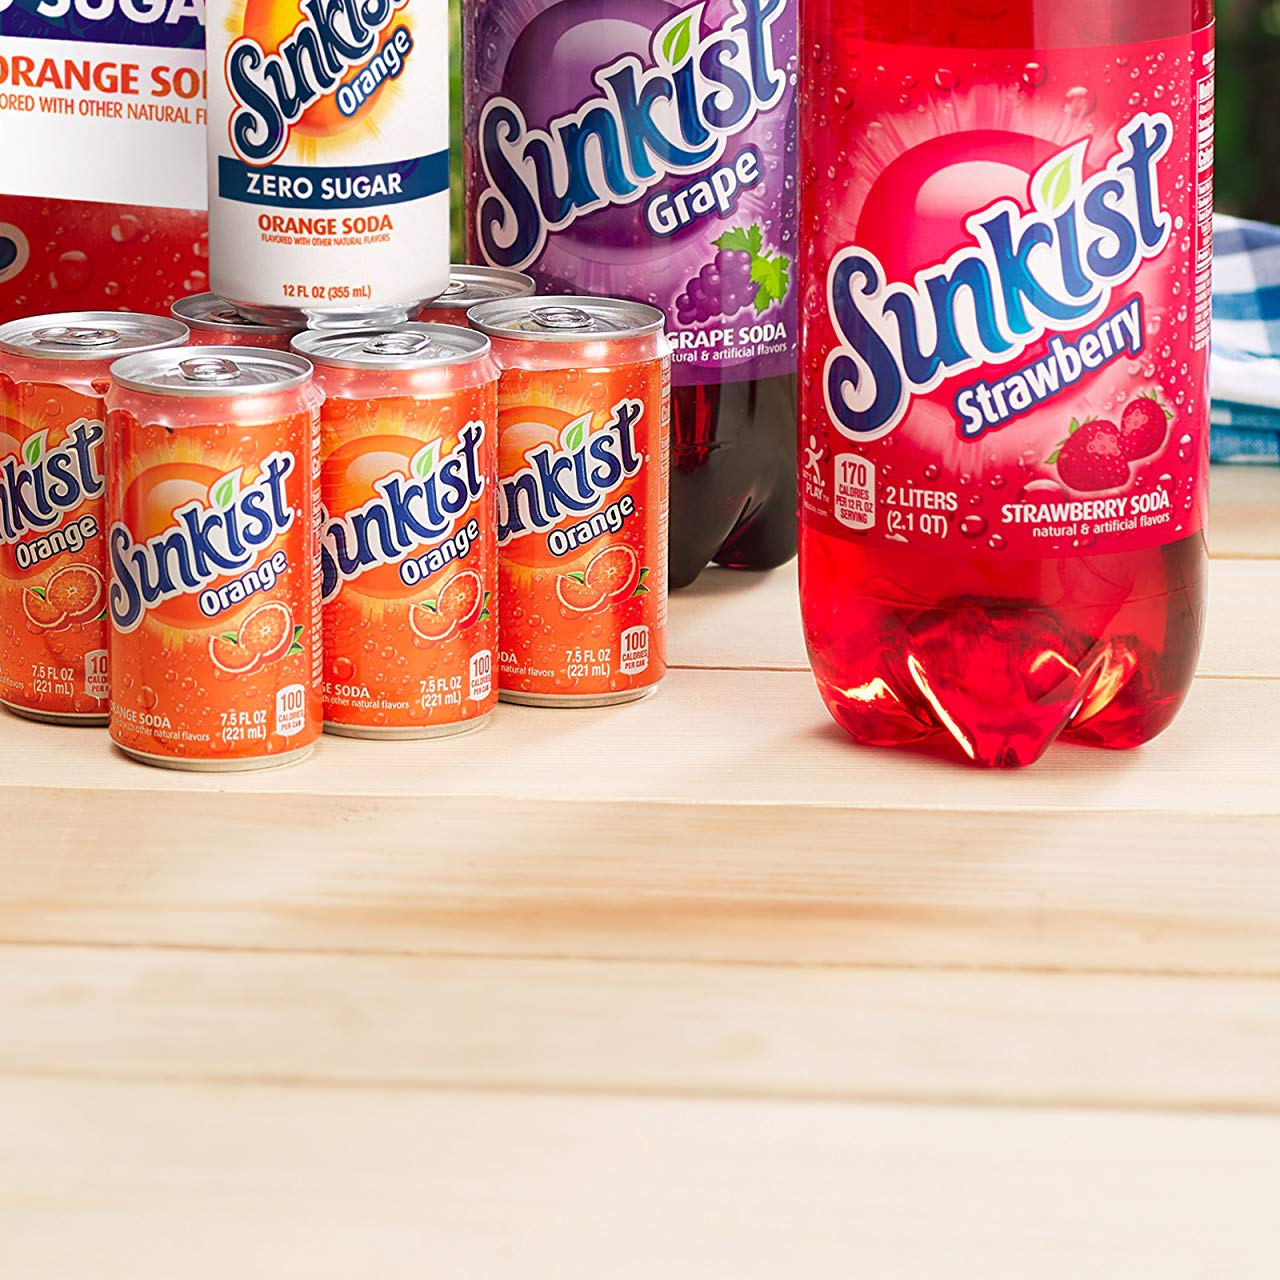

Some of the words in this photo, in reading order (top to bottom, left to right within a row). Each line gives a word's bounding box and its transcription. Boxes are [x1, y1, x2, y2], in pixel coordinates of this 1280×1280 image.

[338, 29, 410, 115] Orange
[151, 66, 207, 99] SO
[39, 96, 74, 115] WITH
[78, 99, 122, 119] OTHER
[127, 103, 192, 125] NATURAL
[246, 172, 313, 199] ZERO
[321, 172, 403, 200] SUGAR
[647, 151, 760, 234] Grape
[258, 214, 337, 235] ORANGE
[341, 214, 393, 235] SODA
[261, 234, 292, 245] FLAVORED
[294, 237, 311, 246] WITH
[312, 237, 332, 247] OTHER
[333, 235, 362, 246] NATURAL
[363, 233, 390, 244] FLAVORS
[828, 122, 1167, 431] Sunkist
[283, 284, 295, 297] 12
[298, 285, 308, 298] FL
[312, 286, 325, 298] OZ
[328, 285, 350, 299] (355
[352, 284, 371, 299] mL)
[667, 329, 734, 350] GRAPE
[738, 322, 787, 344] SODA
[672, 351, 698, 362] tural
[700, 350, 709, 361] &
[712, 346, 755, 360] artificial
[758, 342, 787, 355] flavors
[956, 303, 1142, 433] Strawberry
[498, 403, 640, 540] nkist
[841, 460, 867, 487] 170
[839, 484, 870, 500] CALORIES
[886, 487, 897, 505] 2
[900, 487, 958, 511] LITERS
[836, 495, 847, 507] PER
[848, 498, 855, 509] 12
[856, 500, 863, 511] FL
[864, 501, 873, 513] OZ
[1001, 497, 1127, 523] STRAWBERRY
[1130, 490, 1170, 515] SODA
[549, 495, 634, 556] Orange
[840, 508, 868, 524] SERVING
[887, 509, 914, 532] (2.1
[920, 514, 948, 539] QT)
[1033, 524, 1077, 538] natural
[1080, 524, 1089, 535] &
[1093, 517, 1137, 534] artificial
[1140, 511, 1170, 528] flavors
[16, 516, 98, 568] Orange
[111, 456, 291, 628] Sunkist
[401, 520, 479, 585] Orange
[200, 552, 288, 617] Orange
[624, 629, 647, 652] 100
[91, 656, 108, 674] 10
[472, 654, 490, 677] 100
[566, 650, 582, 663] 7.5
[584, 650, 595, 662] FL
[598, 649, 611, 662] OZ
[622, 650, 648, 662] CALORIES
[624, 660, 635, 670] PER
[32, 665, 46, 678] 7.5
[48, 666, 58, 680] FL
[61, 668, 74, 681] OZ
[501, 665, 526, 675] natural
[528, 666, 555, 677] flavors
[567, 664, 589, 678] (221
[591, 663, 611, 678] mL)
[33, 679, 52, 694] (221
[55, 683, 74, 698] mL)
[420, 680, 436, 693] 7.5
[437, 678, 448, 692] FL
[450, 676, 462, 690] OZ
[471, 675, 491, 688] CALORIES
[473, 686, 481, 696] PER
[280, 689, 303, 711] 100
[335, 684, 370, 699] SODA
[421, 693, 443, 709] (221
[444, 691, 462, 706] mL)
[328, 696, 349, 706] other
[352, 699, 379, 709] natural
[381, 700, 410, 710] flavors
[139, 713, 171, 729] SODA
[220, 713, 237, 726] 7.5
[239, 711, 251, 725] FL
[253, 710, 267, 723] OZ
[278, 711, 304, 722] CALORIES
[281, 721, 291, 731] PER
[136, 724, 152, 736] other
[154, 727, 181, 740] natural
[182, 730, 210, 742] flavors
[222, 727, 245, 742] (221
[248, 725, 267, 740] mL)
